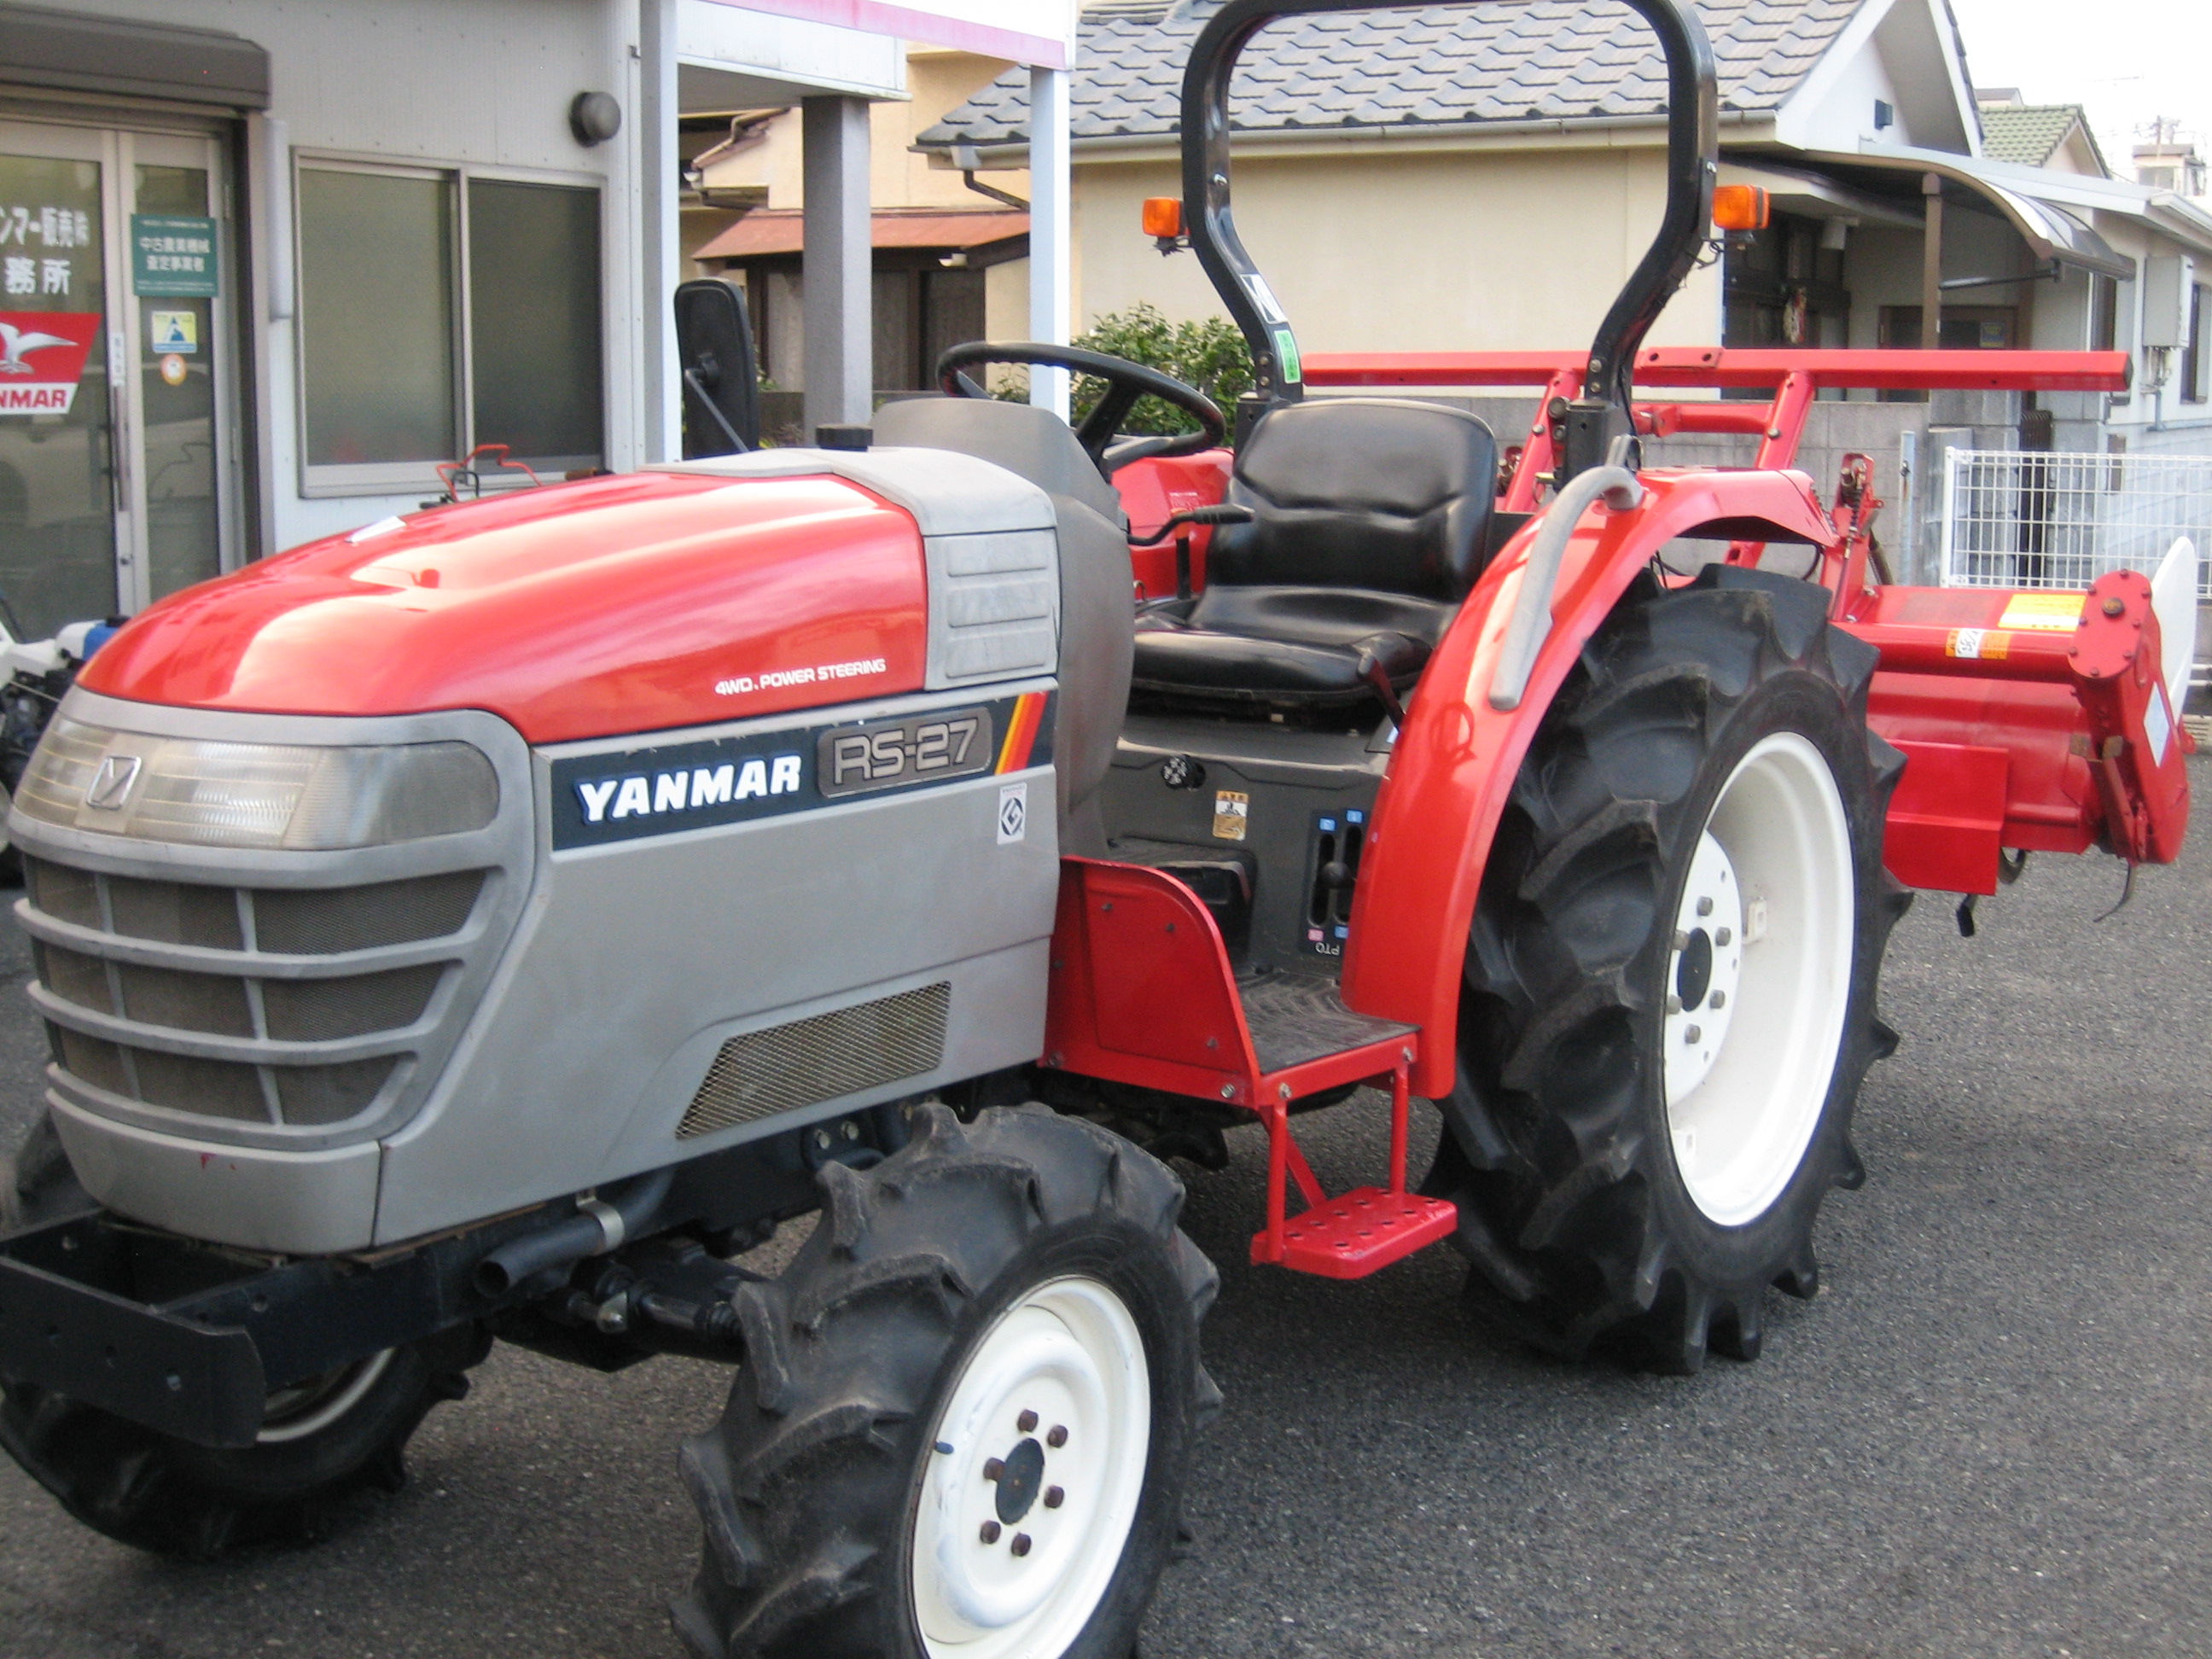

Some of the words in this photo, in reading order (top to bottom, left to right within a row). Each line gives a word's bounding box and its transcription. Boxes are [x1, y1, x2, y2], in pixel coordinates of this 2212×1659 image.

[760, 668, 815, 690] POWER
[817, 658, 886, 681] STEERING
[833, 718, 976, 786] RS-27
[579, 754, 802, 823] YANMAR
